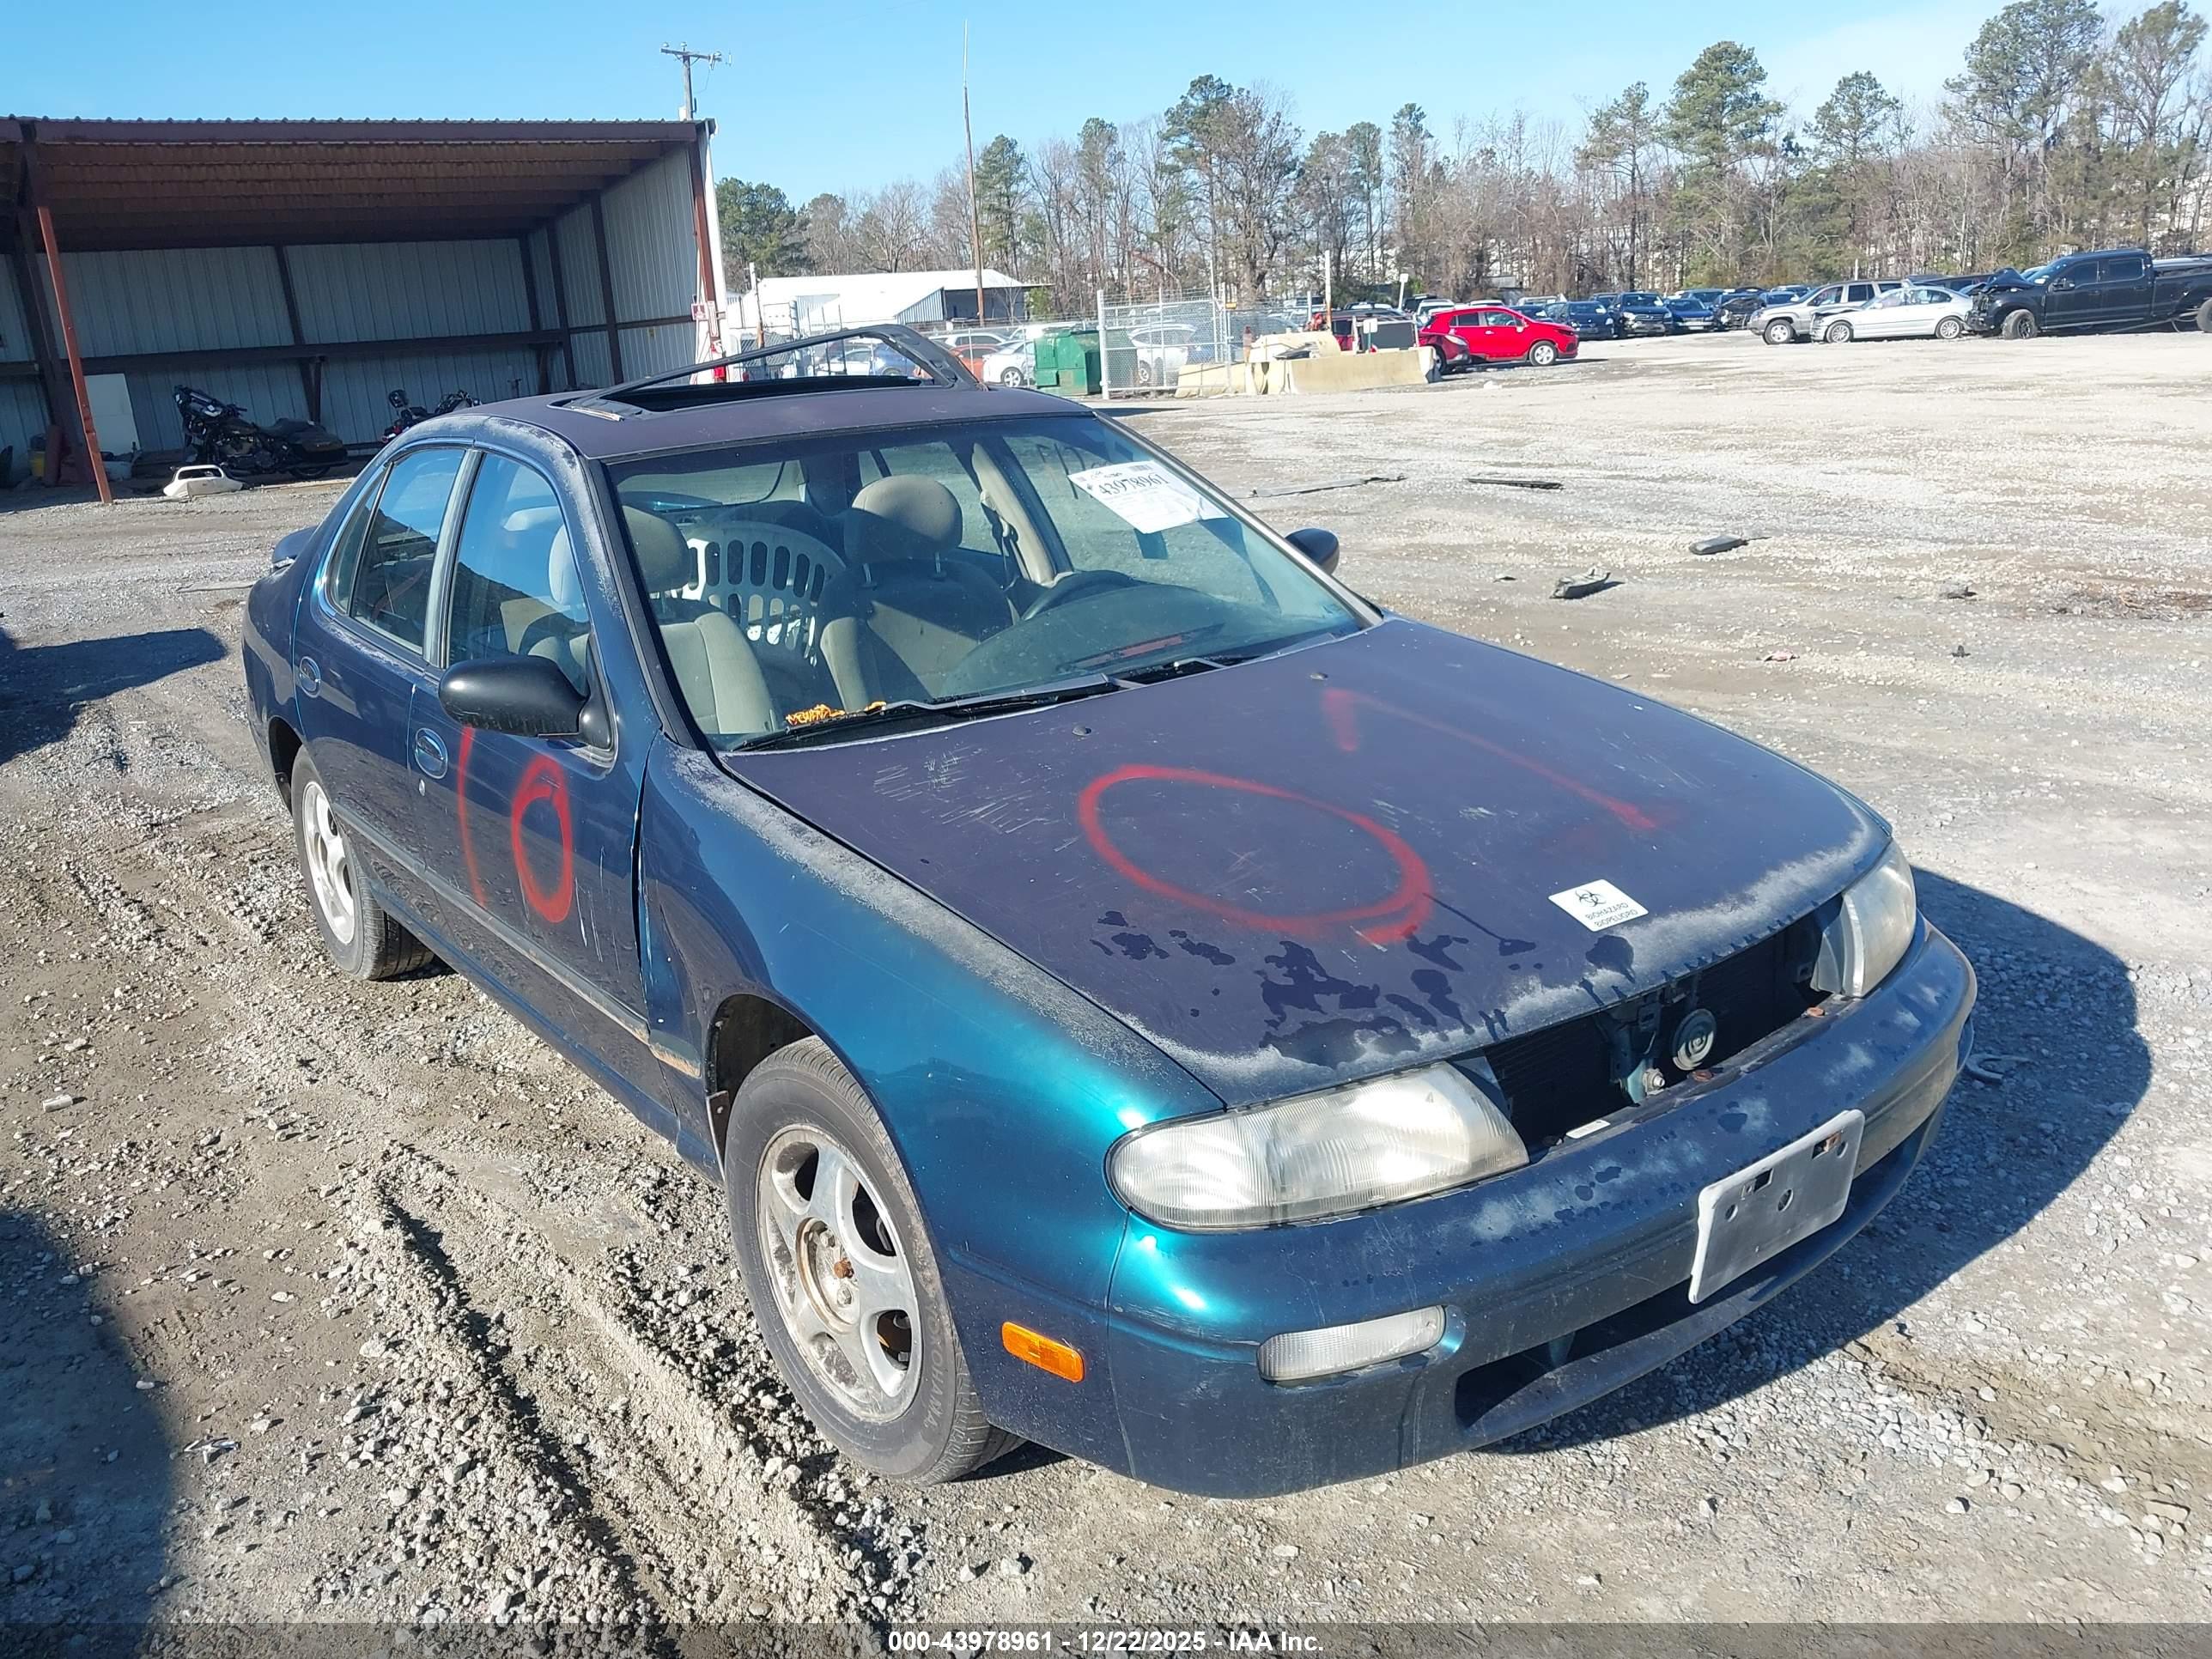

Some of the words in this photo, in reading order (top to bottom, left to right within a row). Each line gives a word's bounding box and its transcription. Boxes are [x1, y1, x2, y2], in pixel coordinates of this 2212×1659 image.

[1098, 473, 1169, 495] 43978961
[1585, 902, 1628, 920] BIOHAZARD
[1594, 909, 1638, 927] BIOPELIGRO
[922, 1299, 944, 1428] YOKOHAMA
